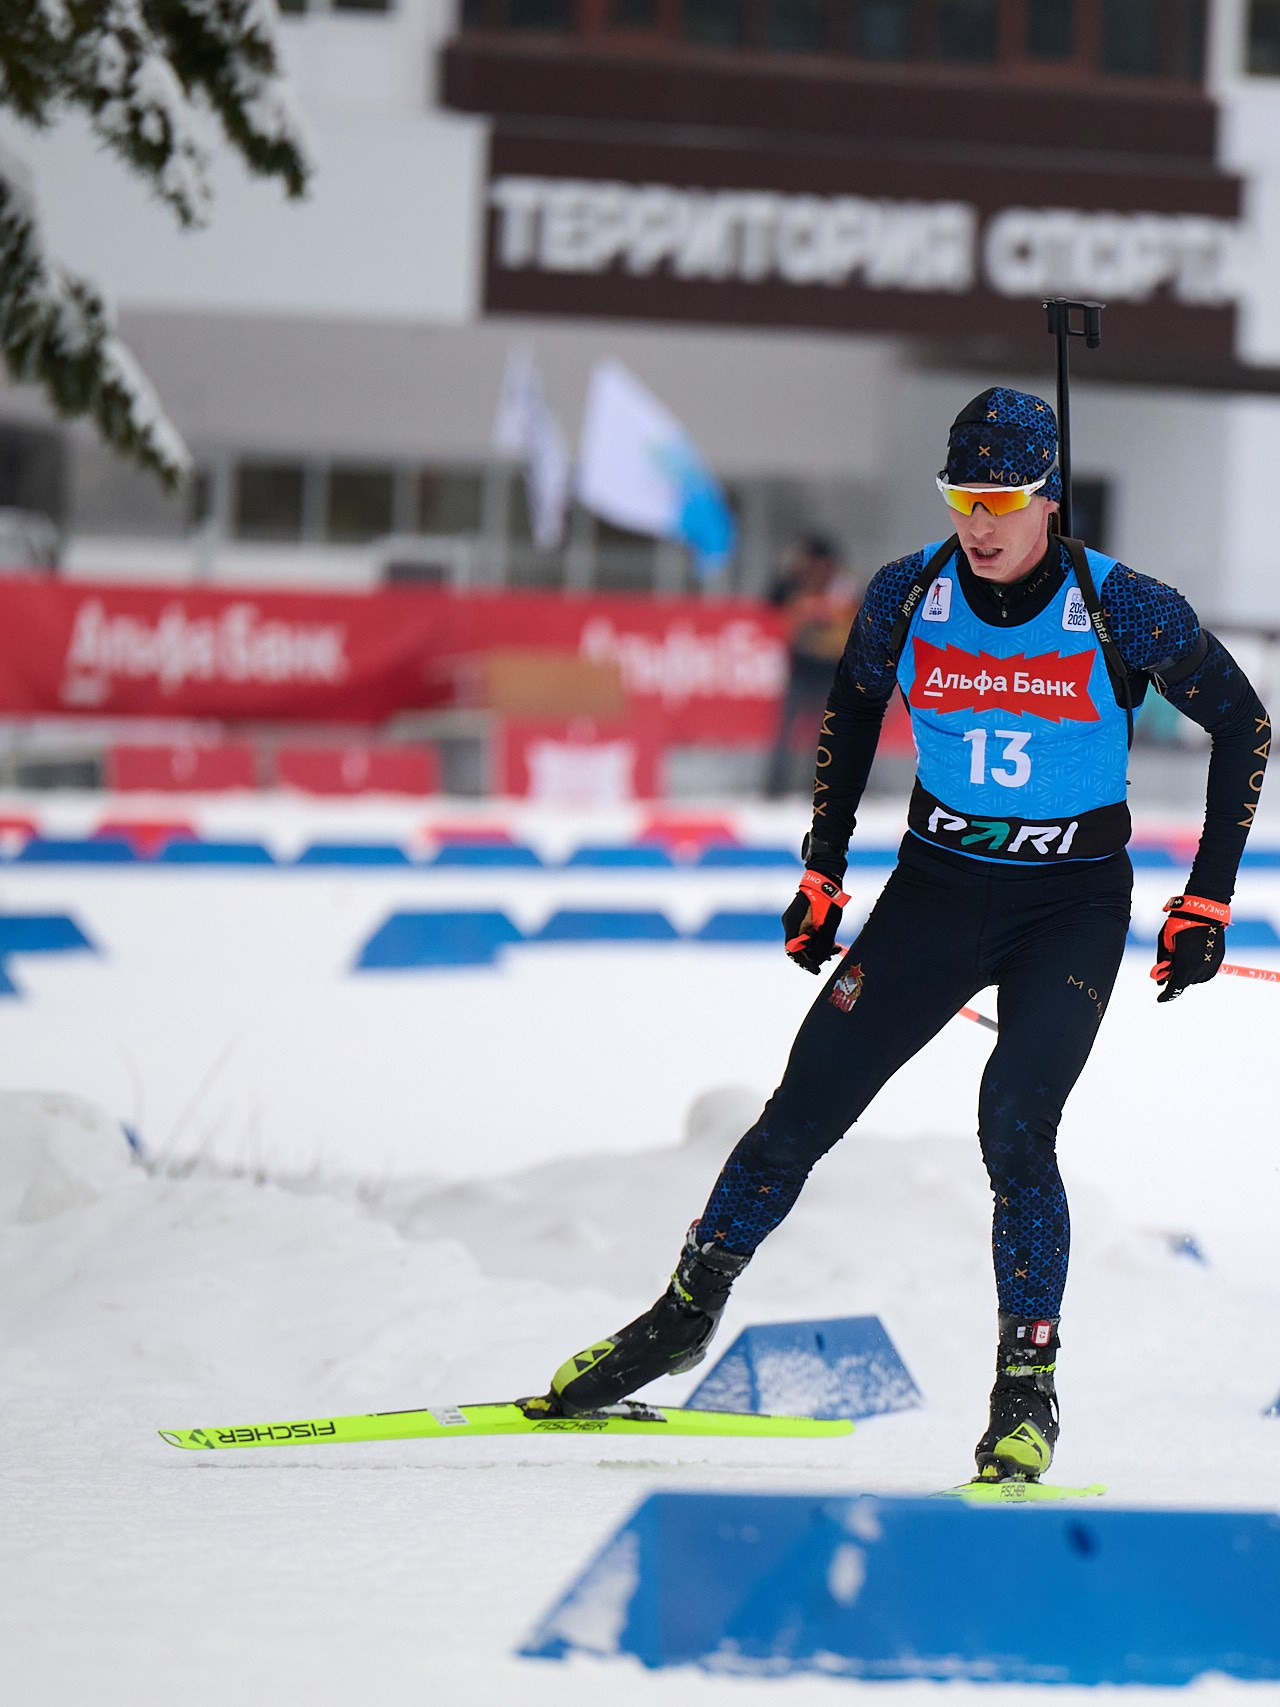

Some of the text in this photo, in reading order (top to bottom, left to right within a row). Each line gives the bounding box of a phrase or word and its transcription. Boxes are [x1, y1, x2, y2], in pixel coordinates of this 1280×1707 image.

[490, 175, 973, 292] ТЕРРИТОРИЯ
[901, 584, 924, 616] biatar
[1067, 613, 1087, 626] 2025
[1091, 611, 1110, 643] biatar
[923, 667, 1077, 698] Альфа Банк
[811, 709, 840, 818] MOAX
[963, 728, 1032, 788] 13
[1237, 713, 1272, 828] MOAX
[927, 806, 1079, 855] PARI
[217, 1421, 336, 1444] FISCHER
[532, 1420, 608, 1432] FISCHER
[1000, 1485, 1026, 1497] FISCHER
